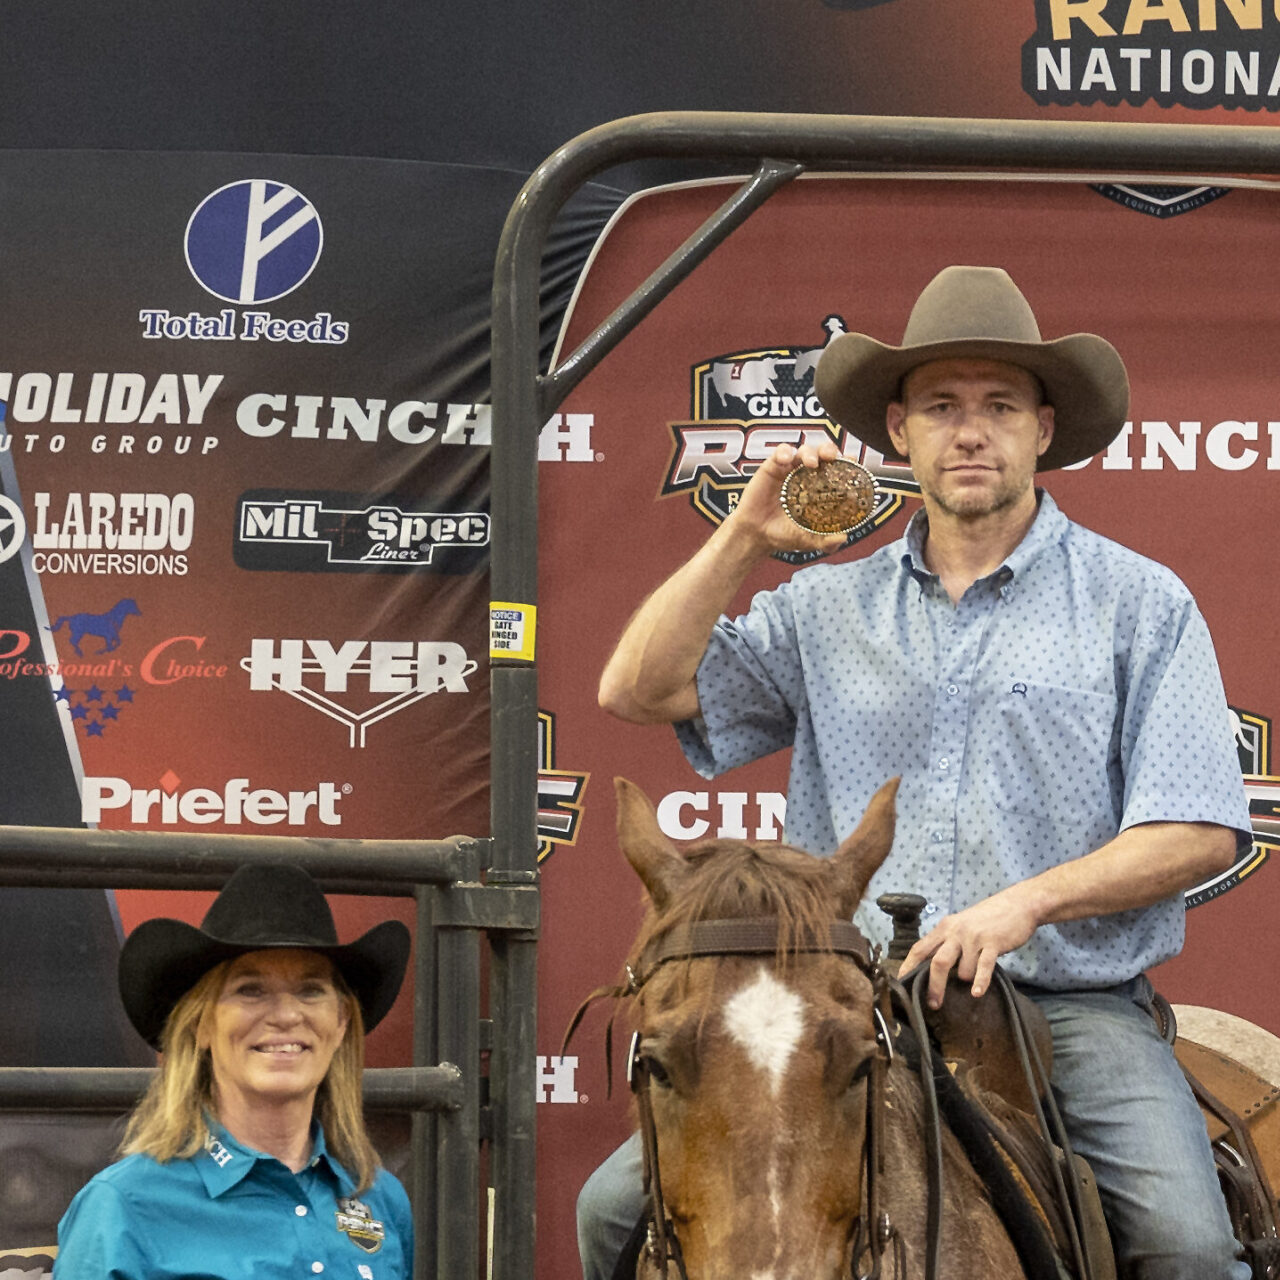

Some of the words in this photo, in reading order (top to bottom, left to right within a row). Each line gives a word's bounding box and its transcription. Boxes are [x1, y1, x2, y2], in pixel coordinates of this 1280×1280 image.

[140, 310, 235, 341] Total
[240, 311, 349, 345] Feeds
[236, 393, 492, 445] CINCH
[748, 396, 830, 417] CINC
[91, 434, 219, 454] GROUP
[33, 492, 195, 551] LAREDO
[245, 505, 319, 538] Mil
[366, 510, 486, 548] Spec
[31, 552, 189, 575] CONVERSIONS
[360, 542, 419, 562] Liner
[139, 635, 229, 686] Choice
[249, 638, 471, 694] HYER
[81, 769, 342, 826] Priefert
[657, 790, 787, 840] CIN
